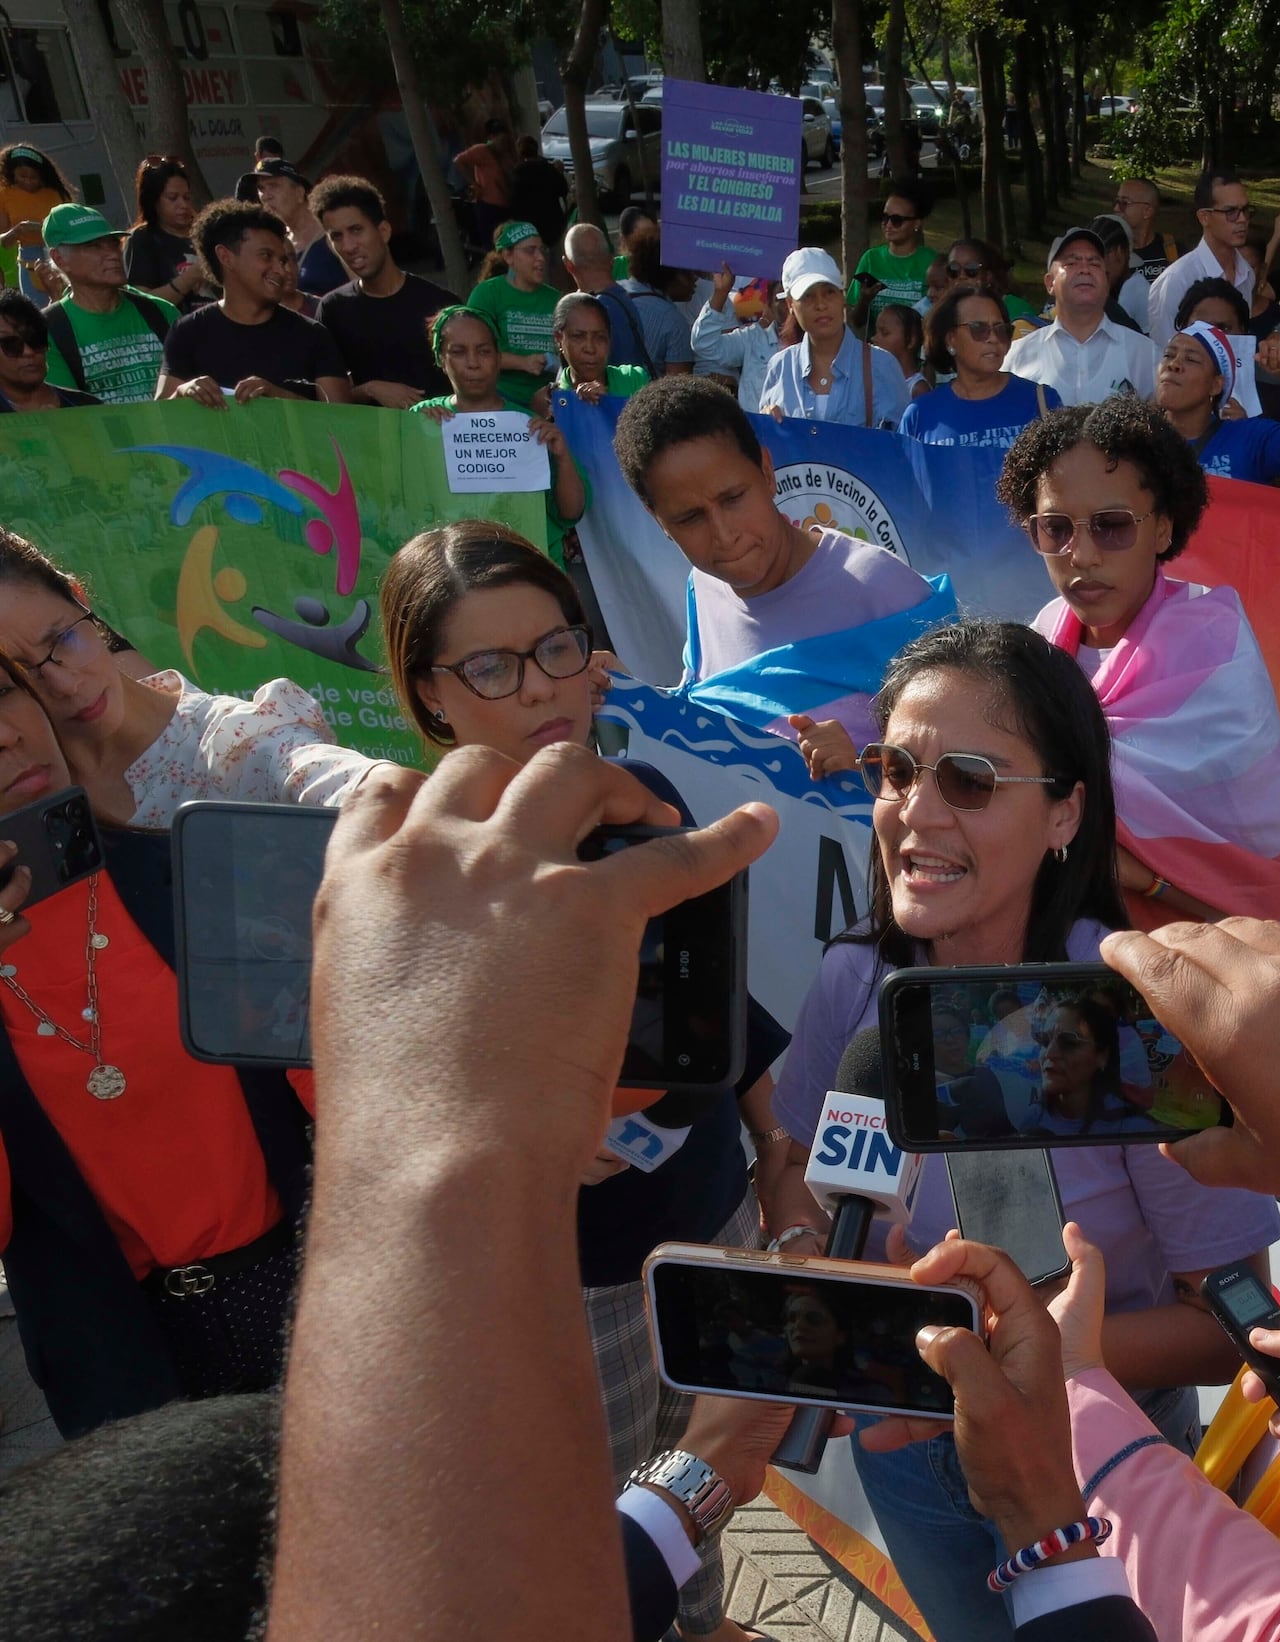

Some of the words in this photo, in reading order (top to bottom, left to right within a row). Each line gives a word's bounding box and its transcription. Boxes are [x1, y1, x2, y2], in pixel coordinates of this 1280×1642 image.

[667, 141, 690, 158] LAS
[691, 144, 745, 166] MUJERES
[747, 151, 795, 173] MUEREN
[666, 160, 689, 175] por
[690, 161, 736, 176] abortos
[737, 164, 795, 185] inseguros
[688, 174, 697, 190] Y
[696, 176, 709, 191] EL
[712, 178, 774, 200] CONGRESO
[678, 194, 698, 211] LES
[701, 197, 715, 213] DA
[718, 200, 731, 216] LA
[733, 201, 783, 222] ESPALDA
[470, 418, 496, 429] NOS
[453, 432, 530, 443] MERECEMOS
[959, 433, 979, 447] DE
[982, 425, 1022, 441] JUNT
[455, 449, 472, 459] UN
[475, 449, 517, 459] MEJOR
[457, 463, 505, 473] CODIGO
[776, 473, 803, 497] unta
[806, 468, 823, 488] de
[826, 471, 868, 508] Vecino
[865, 500, 879, 522] la
[308, 682, 341, 702] de
[323, 706, 353, 728] de
[827, 1109, 887, 1130] NOTICI
[815, 1125, 902, 1177] SIN
[1218, 1271, 1241, 1287] SONY
